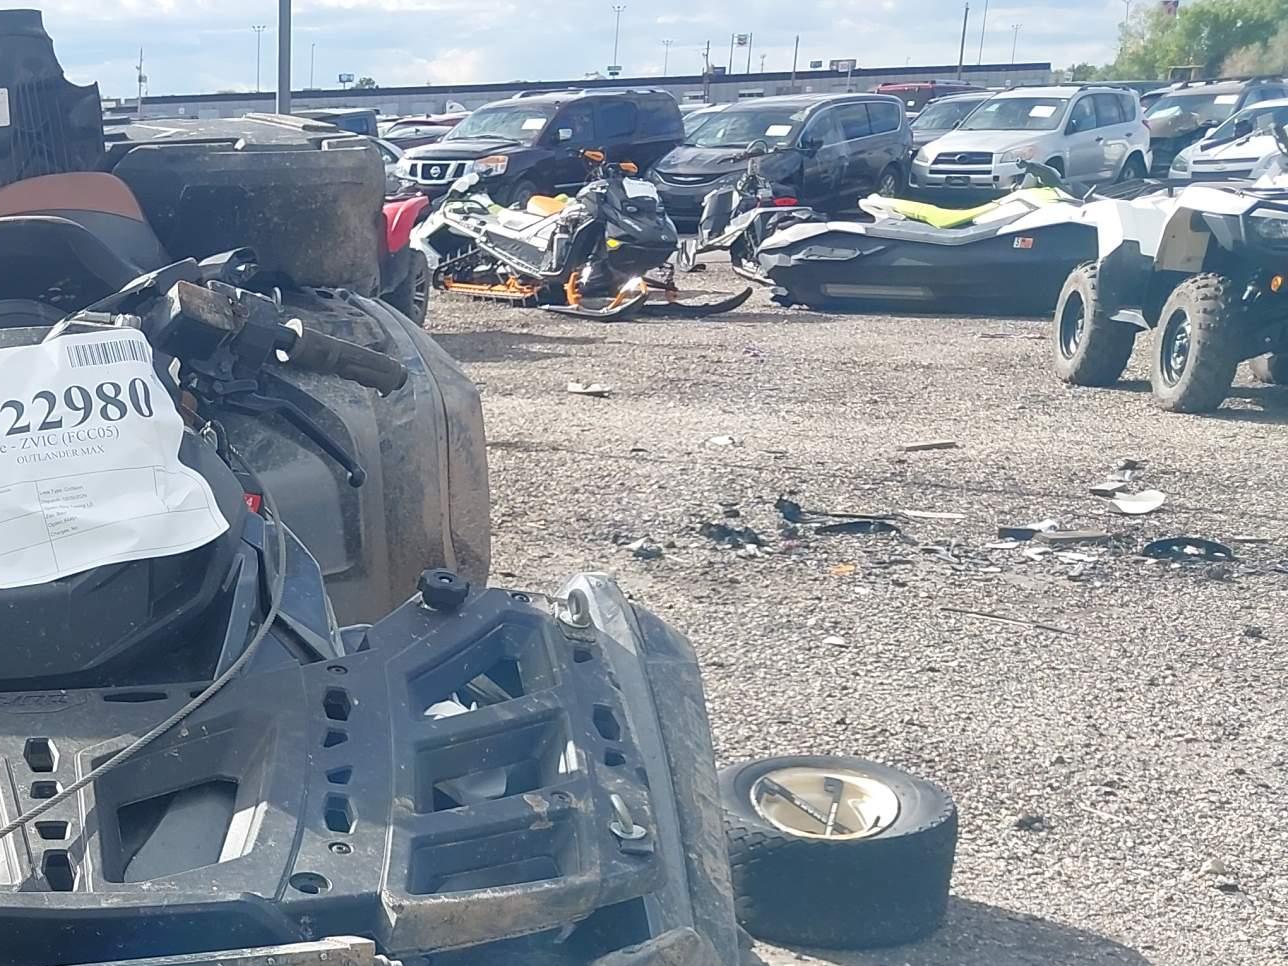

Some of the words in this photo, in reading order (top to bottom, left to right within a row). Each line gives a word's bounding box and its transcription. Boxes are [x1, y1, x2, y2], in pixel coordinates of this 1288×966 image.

[20, 433, 59, 450] ZVIC
[61, 424, 120, 446] (FCC05)
[16, 447, 80, 465] OUTLANDER
[80, 444, 106, 457] MAX
